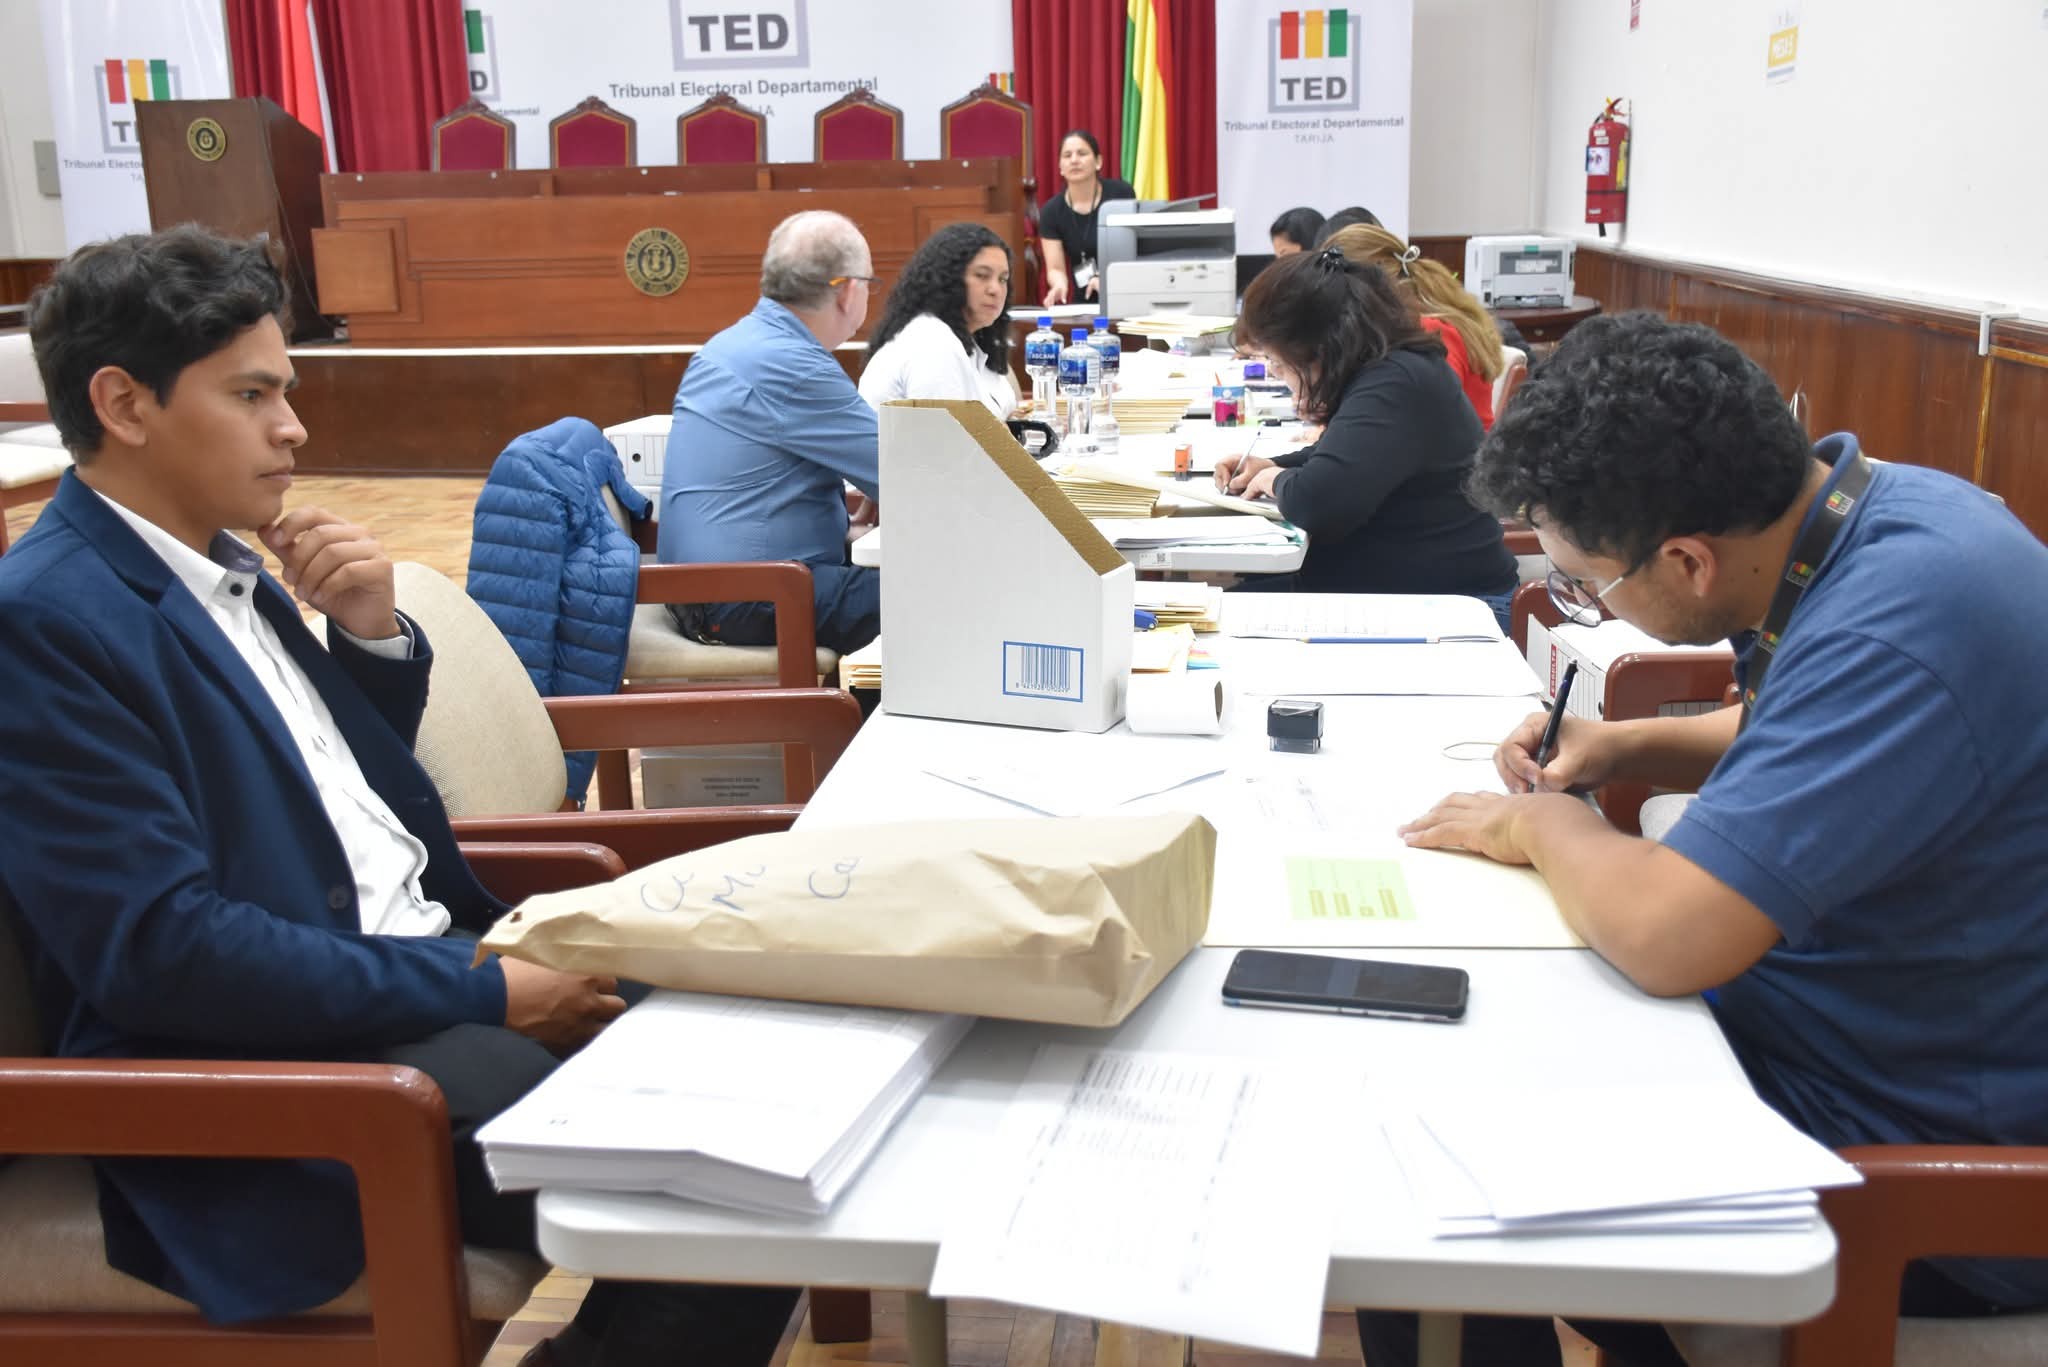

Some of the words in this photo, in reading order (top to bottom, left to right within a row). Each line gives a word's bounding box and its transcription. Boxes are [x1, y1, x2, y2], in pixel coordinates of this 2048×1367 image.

[688, 13, 789, 52] TED
[470, 70, 488, 91] D
[609, 83, 675, 98] Tribunal
[681, 80, 751, 96] Electoral
[758, 77, 878, 96] Departamental
[1280, 76, 1347, 101] TED
[112, 121, 138, 142] T
[1224, 121, 1268, 131] Tribunal
[1271, 119, 1320, 129] Electoral
[1323, 117, 1404, 129] Departamental
[1294, 134, 1334, 144] TARIJA
[63, 160, 106, 169] Tribunal
[108, 160, 143, 169] Electo
